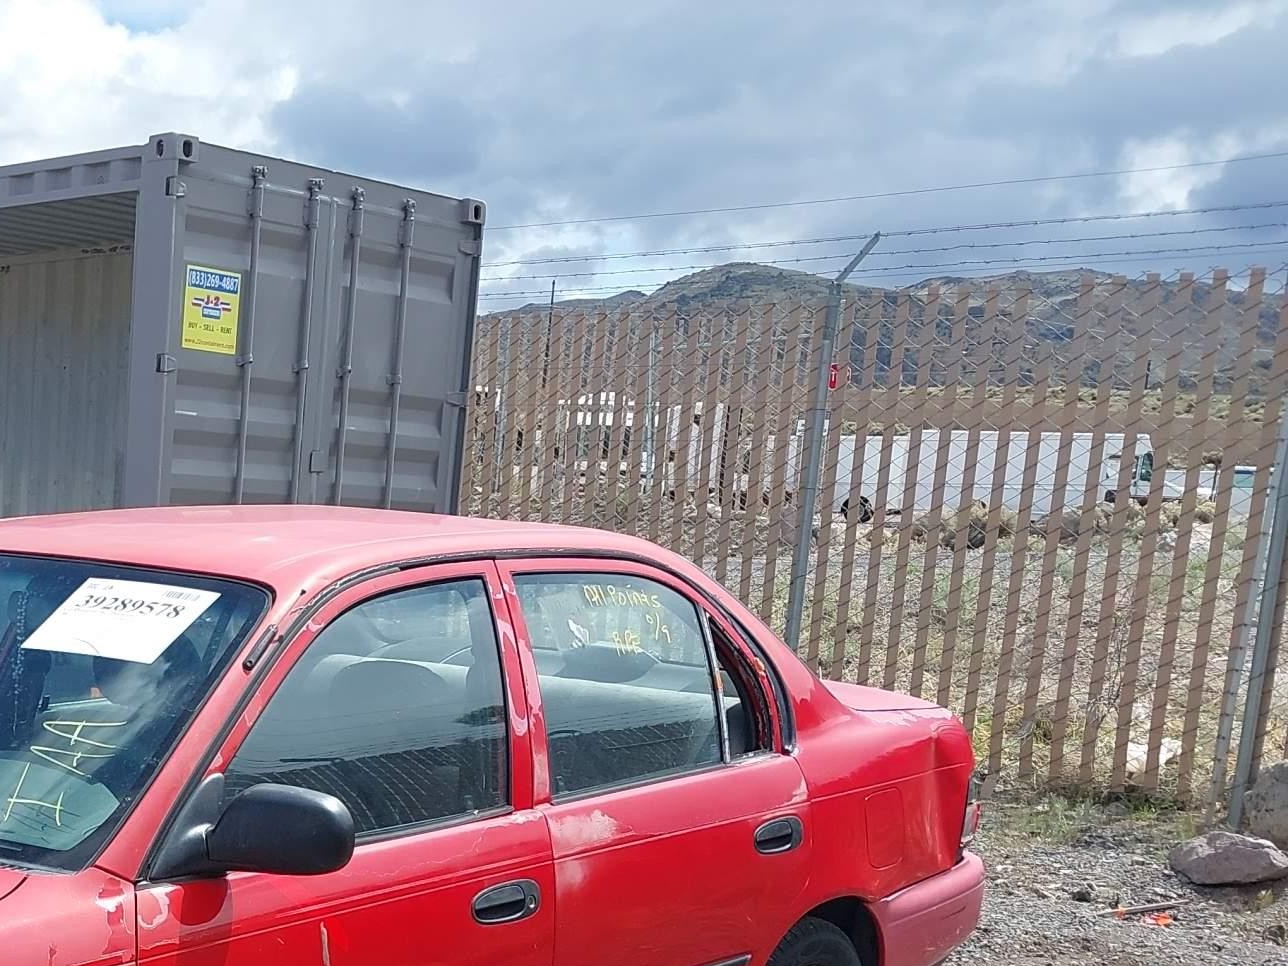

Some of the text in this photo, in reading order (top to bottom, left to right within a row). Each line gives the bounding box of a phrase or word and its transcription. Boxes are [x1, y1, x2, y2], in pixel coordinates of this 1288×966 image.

[189, 270, 238, 291] (833)269-4887
[188, 321, 198, 329] BUY
[203, 323, 214, 332] SELL
[220, 326, 232, 335] RENT
[75, 594, 185, 618] 39289578
